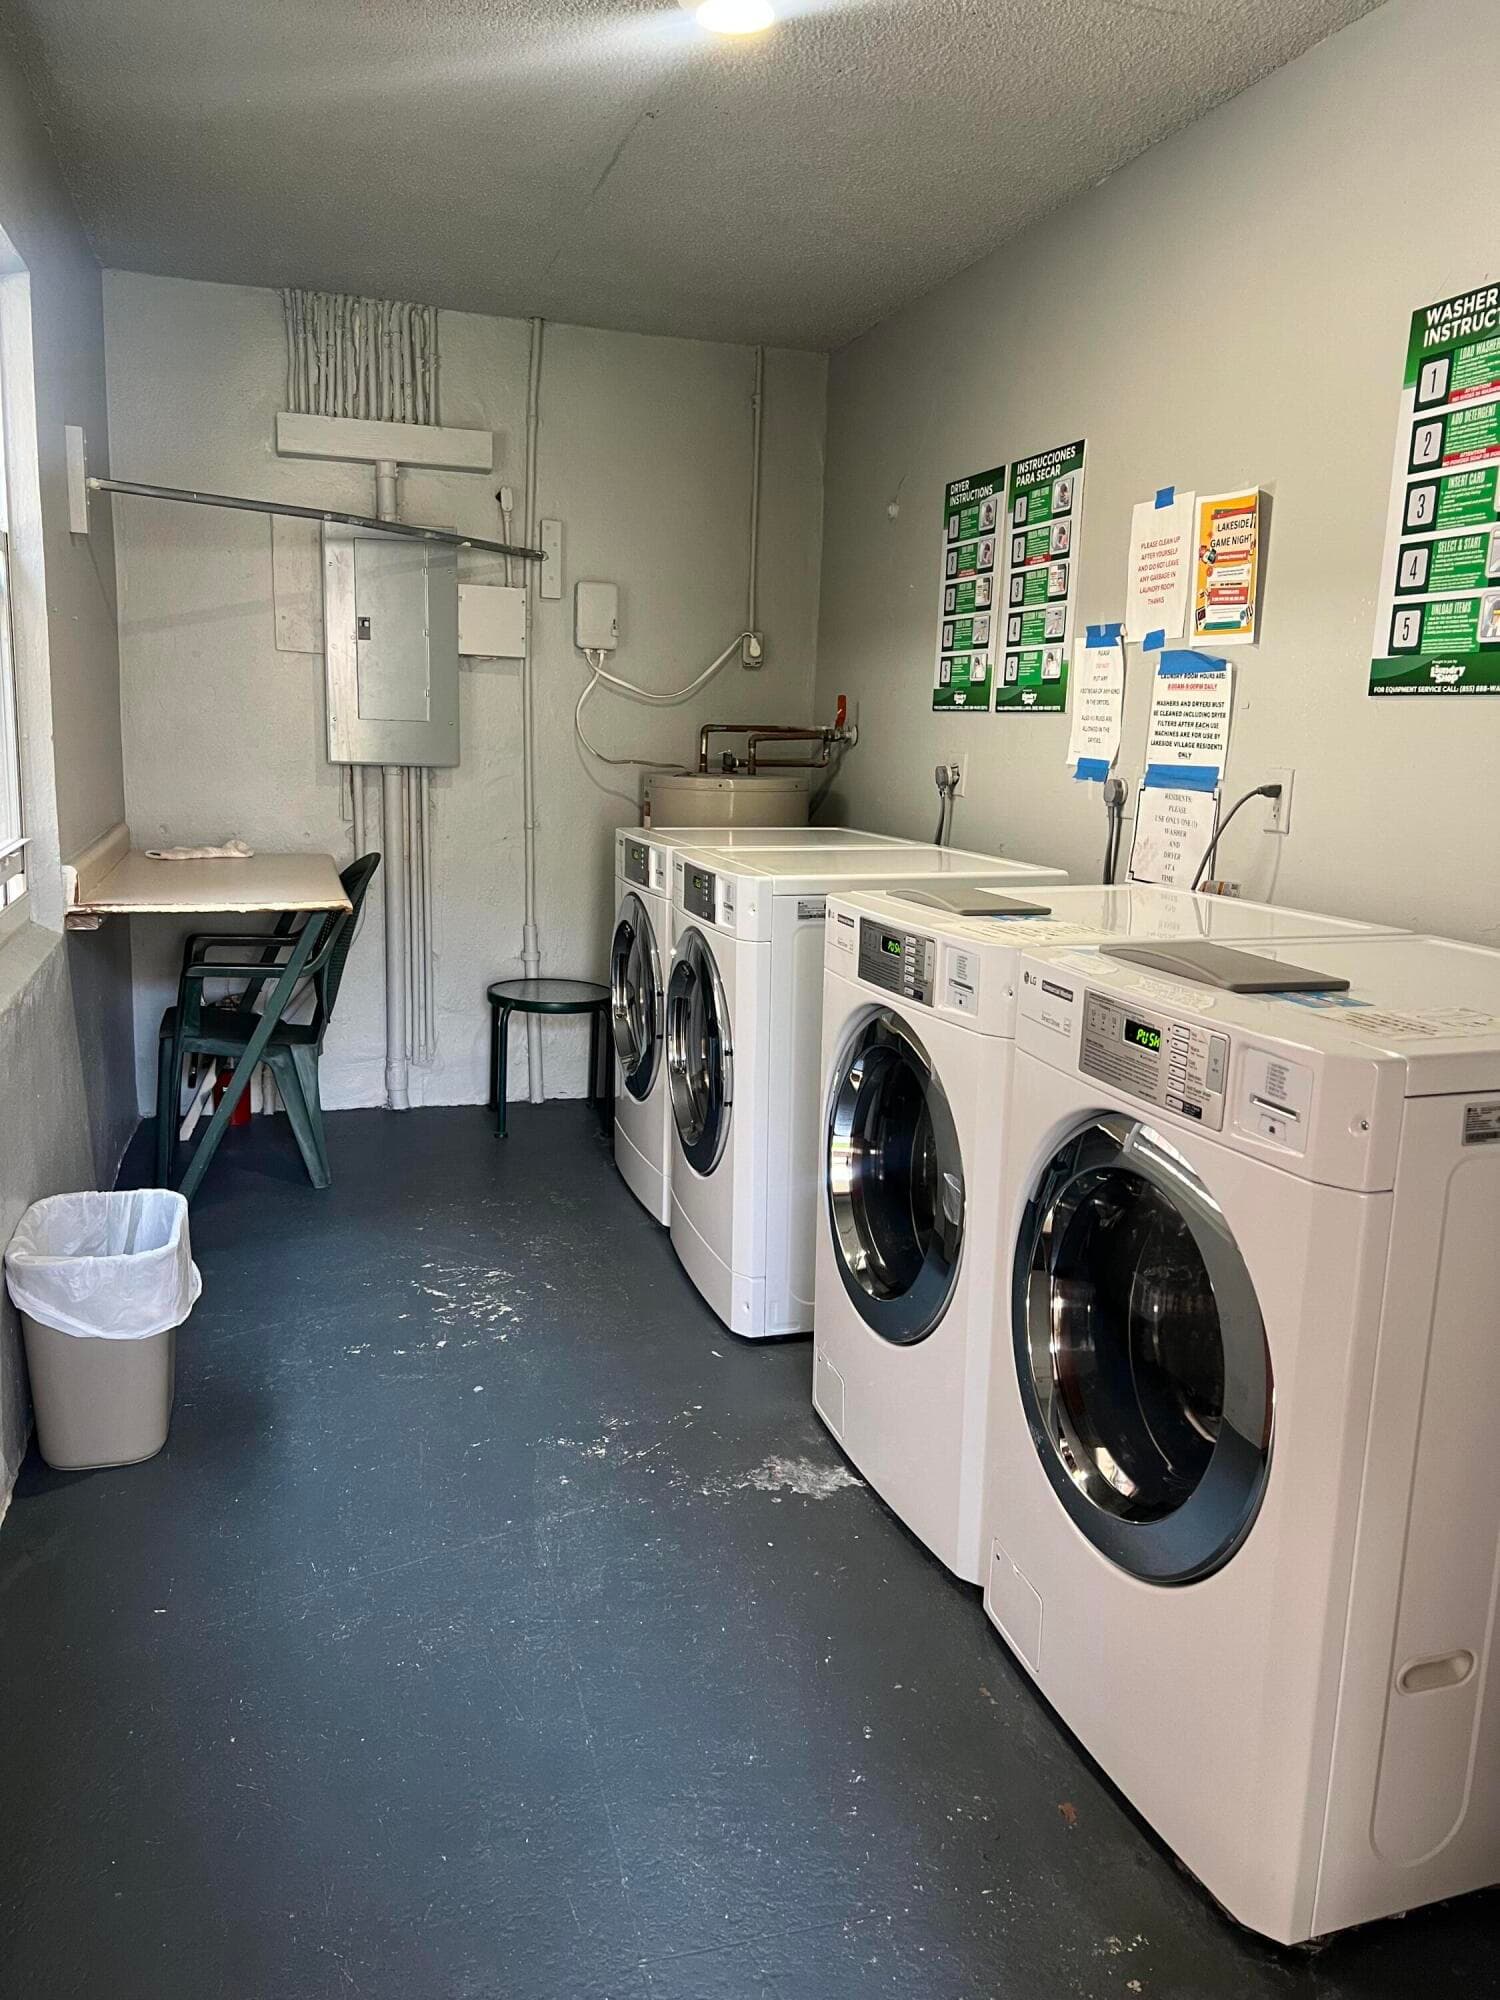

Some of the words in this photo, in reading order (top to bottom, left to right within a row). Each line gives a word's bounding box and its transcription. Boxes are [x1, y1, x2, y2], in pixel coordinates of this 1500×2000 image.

[1426, 288, 1499, 327] WASHER
[1431, 367, 1437, 393] 1
[1451, 411, 1464, 425] ADD
[1464, 403, 1496, 423] DETERGENT
[1423, 431, 1432, 457] 2
[1017, 446, 1076, 475] INSTRUCCIONES
[1016, 473, 1036, 488] PARA
[1036, 465, 1061, 482] SECAR
[1448, 473, 1468, 489] INSERT
[1469, 471, 1486, 485] CARD
[950, 480, 970, 494] DRYER
[949, 484, 993, 506] INSTRUCTIONS
[1417, 494, 1426, 518] 3
[1217, 518, 1250, 532] LAKESIDE
[1140, 540, 1158, 549] PLEASE
[1158, 537, 1173, 546] CLEAN
[1210, 537, 1231, 548] GAME
[1231, 533, 1253, 545] NIGHT
[1438, 539, 1457, 553] SELECT
[1463, 536, 1482, 549] START
[1141, 551, 1156, 560] AFTER
[1156, 548, 1178, 558] YOURSELF
[1138, 564, 1148, 572] AND
[1156, 561, 1165, 569] NOT
[1165, 559, 1179, 568] LEAVE
[1409, 555, 1418, 580] 4
[1140, 575, 1149, 583] ANY
[1149, 572, 1170, 581] GARBAGE
[1139, 585, 1160, 594] LAUNDRY
[1148, 596, 1164, 605] THANKS
[1431, 602, 1453, 616] UNLOAD
[1454, 601, 1472, 614] ITEMS
[1402, 617, 1411, 641] 5
[1385, 686, 1417, 694] EQUIPMENT
[1168, 805, 1187, 814] PLEASE
[1154, 815, 1165, 823] USE
[1165, 816, 1180, 825] ONLY
[1164, 828, 1187, 837] WASHER
[1169, 841, 1181, 849] AND
[1163, 851, 1181, 860] DRYER
[1161, 874, 1174, 883] TIME
[1136, 1028, 1161, 1048] PUSH
